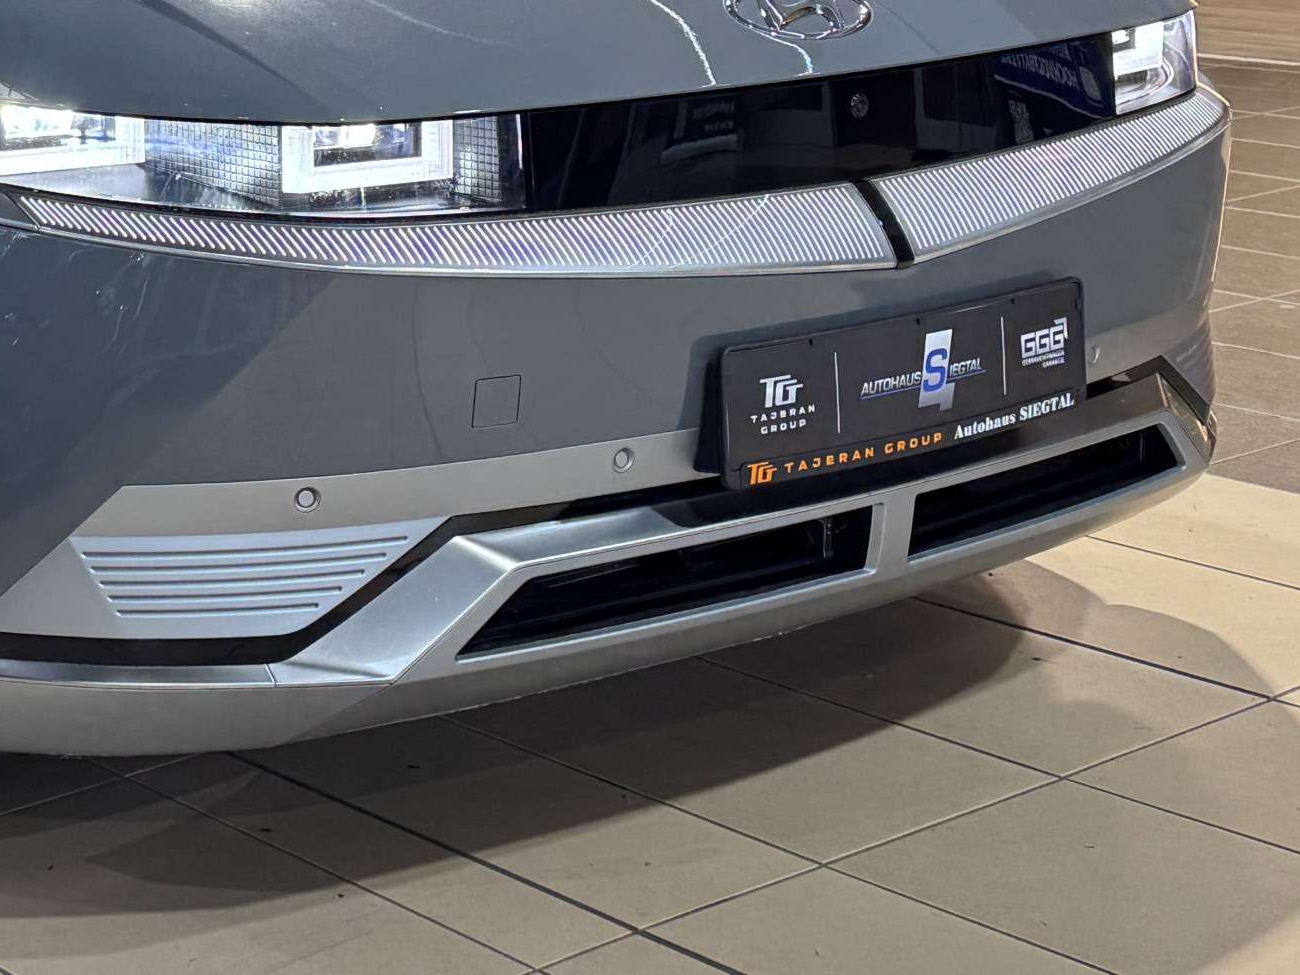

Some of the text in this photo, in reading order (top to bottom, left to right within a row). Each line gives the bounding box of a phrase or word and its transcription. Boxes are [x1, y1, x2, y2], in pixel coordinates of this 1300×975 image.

[1020, 323, 1065, 359] GGG
[861, 371, 921, 396] AUTOHAUS
[750, 403, 815, 424] TAJERAN
[760, 418, 807, 435] GROUP
[783, 447, 875, 474] TAJERAN
[884, 431, 943, 455] GROUP
[953, 410, 1016, 441] Autohaus
[1018, 391, 1074, 422] SIEGTAL
